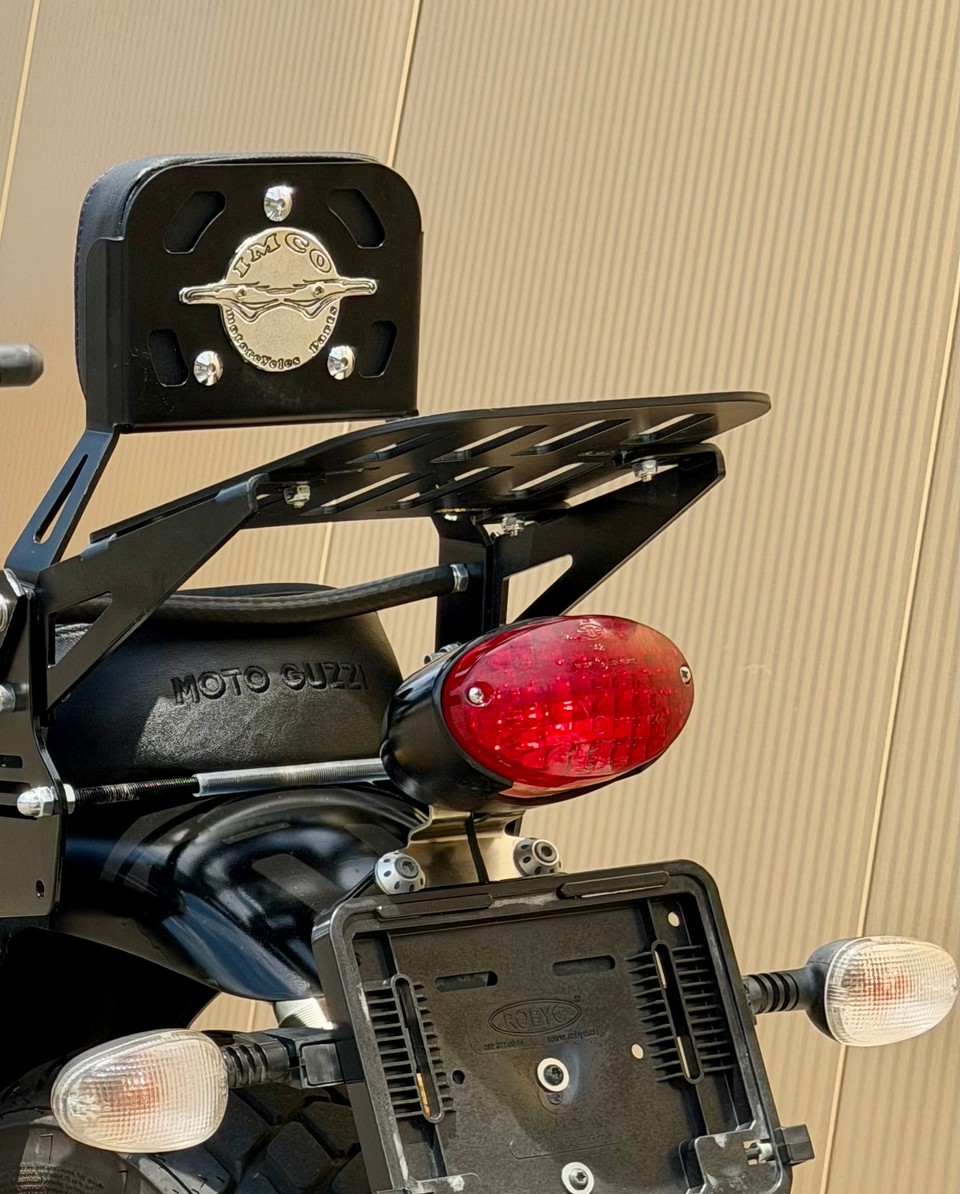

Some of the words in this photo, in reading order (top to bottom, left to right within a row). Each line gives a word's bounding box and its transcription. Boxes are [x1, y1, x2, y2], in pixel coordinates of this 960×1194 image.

[233, 232, 332, 278] IMCO
[170, 664, 271, 706] MOTO
[280, 660, 369, 692] GUZZI
